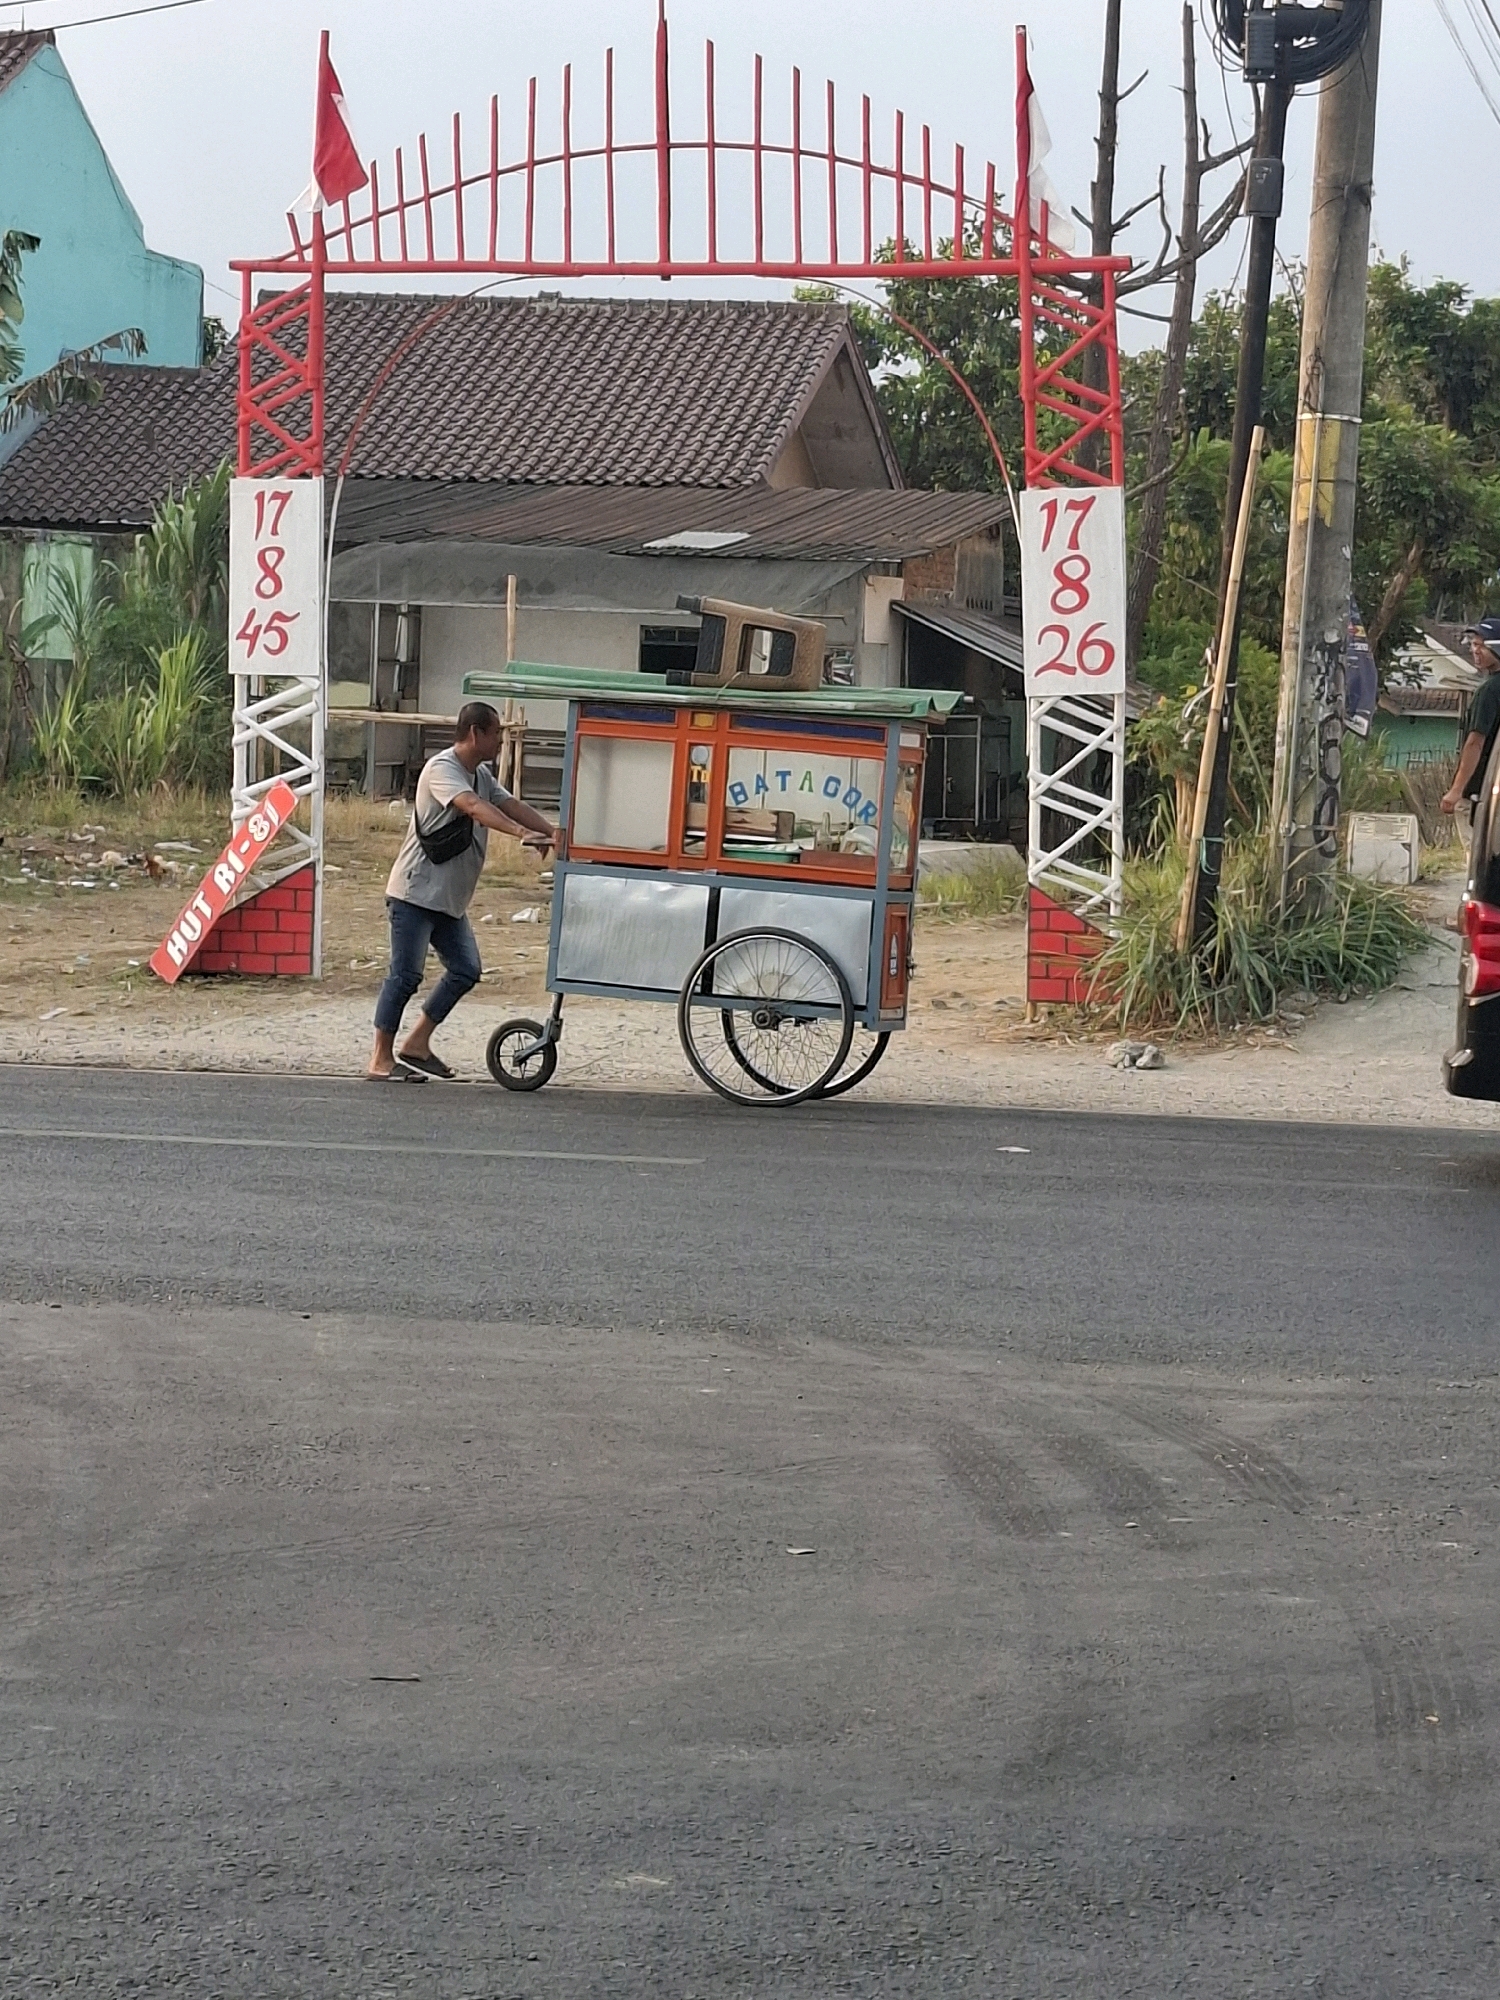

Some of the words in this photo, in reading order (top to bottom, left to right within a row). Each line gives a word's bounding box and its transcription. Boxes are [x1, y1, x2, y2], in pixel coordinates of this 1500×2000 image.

[254, 490, 294, 541] 17
[1039, 495, 1096, 552] 17
[255, 545, 286, 600] 8
[1050, 554, 1091, 615] 8
[235, 607, 301, 659] 45
[1034, 622, 1115, 678] 26
[728, 770, 878, 824] BATAGOR
[165, 890, 213, 968] HUT
